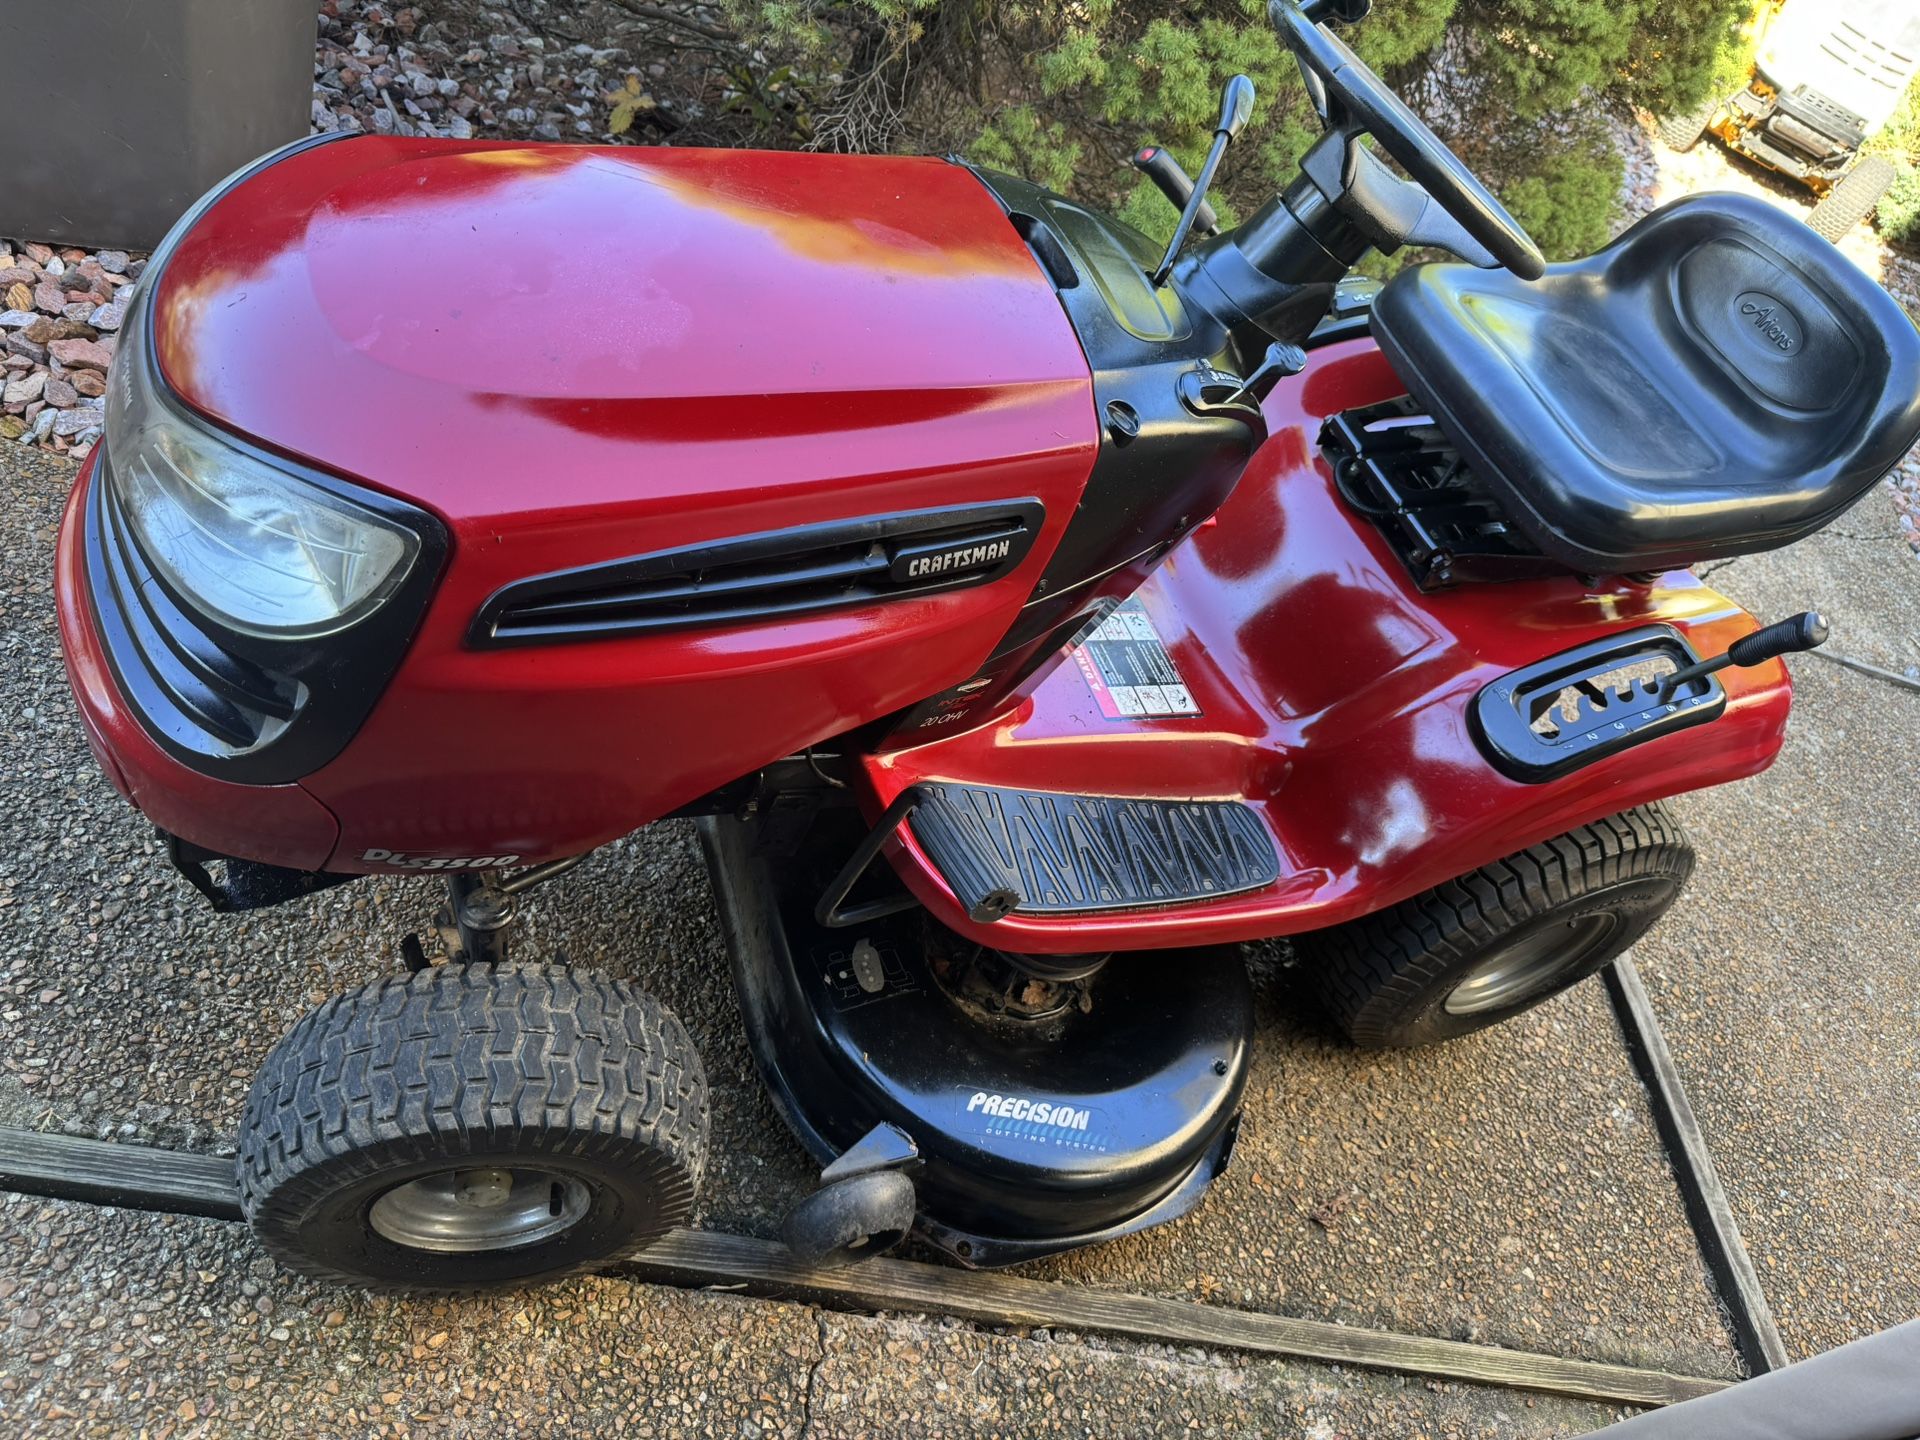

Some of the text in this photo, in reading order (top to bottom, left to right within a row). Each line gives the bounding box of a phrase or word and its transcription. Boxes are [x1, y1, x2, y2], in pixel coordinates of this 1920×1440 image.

[1741, 302, 1794, 351] Ariens
[909, 540, 1010, 577] CRAFTSMAN
[919, 708, 970, 728] 20 OHV
[1586, 733, 1599, 741] 2
[1613, 722, 1625, 730] 3
[1641, 712, 1652, 720] 4
[1690, 697, 1701, 706] 6
[362, 848, 520, 870] DLS3500
[967, 1092, 1090, 1130] PRECISION
[986, 1127, 1106, 1152] CUTTING SYSTEM
